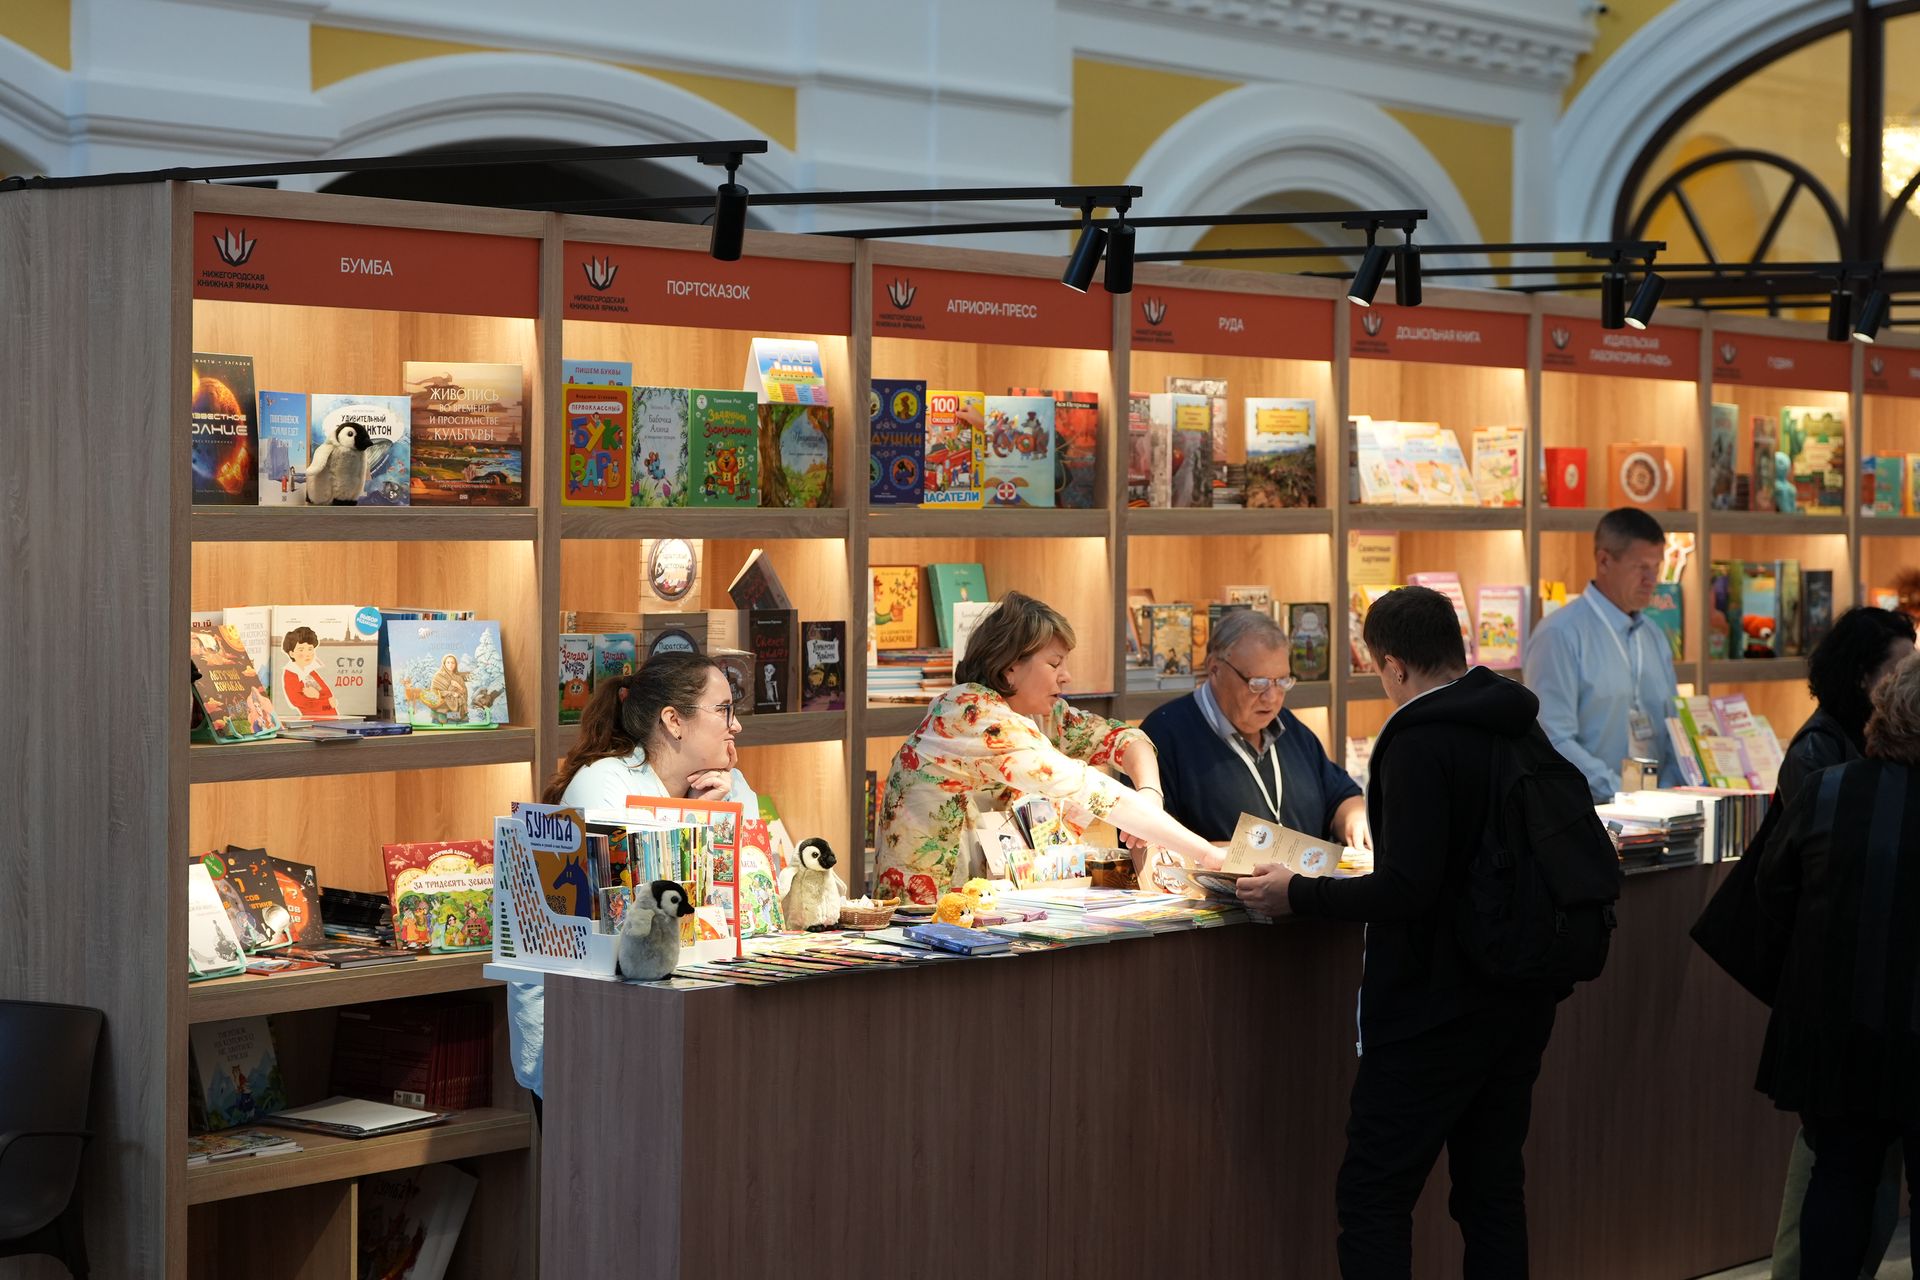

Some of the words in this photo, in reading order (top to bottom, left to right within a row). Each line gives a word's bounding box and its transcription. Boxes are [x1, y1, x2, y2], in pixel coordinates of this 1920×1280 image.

[340, 257, 394, 276] БУМБА
[202, 270, 265, 281] НИЖЕГОРОДСКАЯ
[197, 279, 234, 289] КНИЖНАЯ
[236, 281, 269, 291] ЯРМАРКА
[667, 280, 750, 300] ПОРТСКАЗОК
[574, 294, 625, 304] НИЖЕГОРОДСКАЯ
[947, 298, 1037, 319] АПРИОРИ-ПРЕСС
[1218, 316, 1244, 332] РУДА
[430, 387, 499, 401] ЖИВОПИСЬ
[440, 404, 450, 413] ВО
[453, 404, 490, 413] ВРЕМЕНИ
[571, 404, 620, 412] ПЕРВОКЛАССНЫЙ
[932, 397, 955, 413] 100
[341, 414, 386, 423] УДИВИТЕЛЬНЫЙ
[429, 416, 436, 424] И
[437, 416, 499, 426] ПРОСТРАНСТВЕ
[648, 414, 672, 424] Бабочка
[434, 428, 494, 441] КУЛЬТУРЫ
[871, 433, 922, 446] ДУШКИ
[924, 491, 979, 503] ПАСАТЕЛИ
[336, 657, 365, 668] СТО
[624, 665, 630, 675] 2
[335, 676, 364, 687] ДОРО
[525, 810, 573, 842] БУМБА
[413, 881, 423, 890] ЗА
[425, 879, 467, 889] ТРИДЕВЯТЬ
